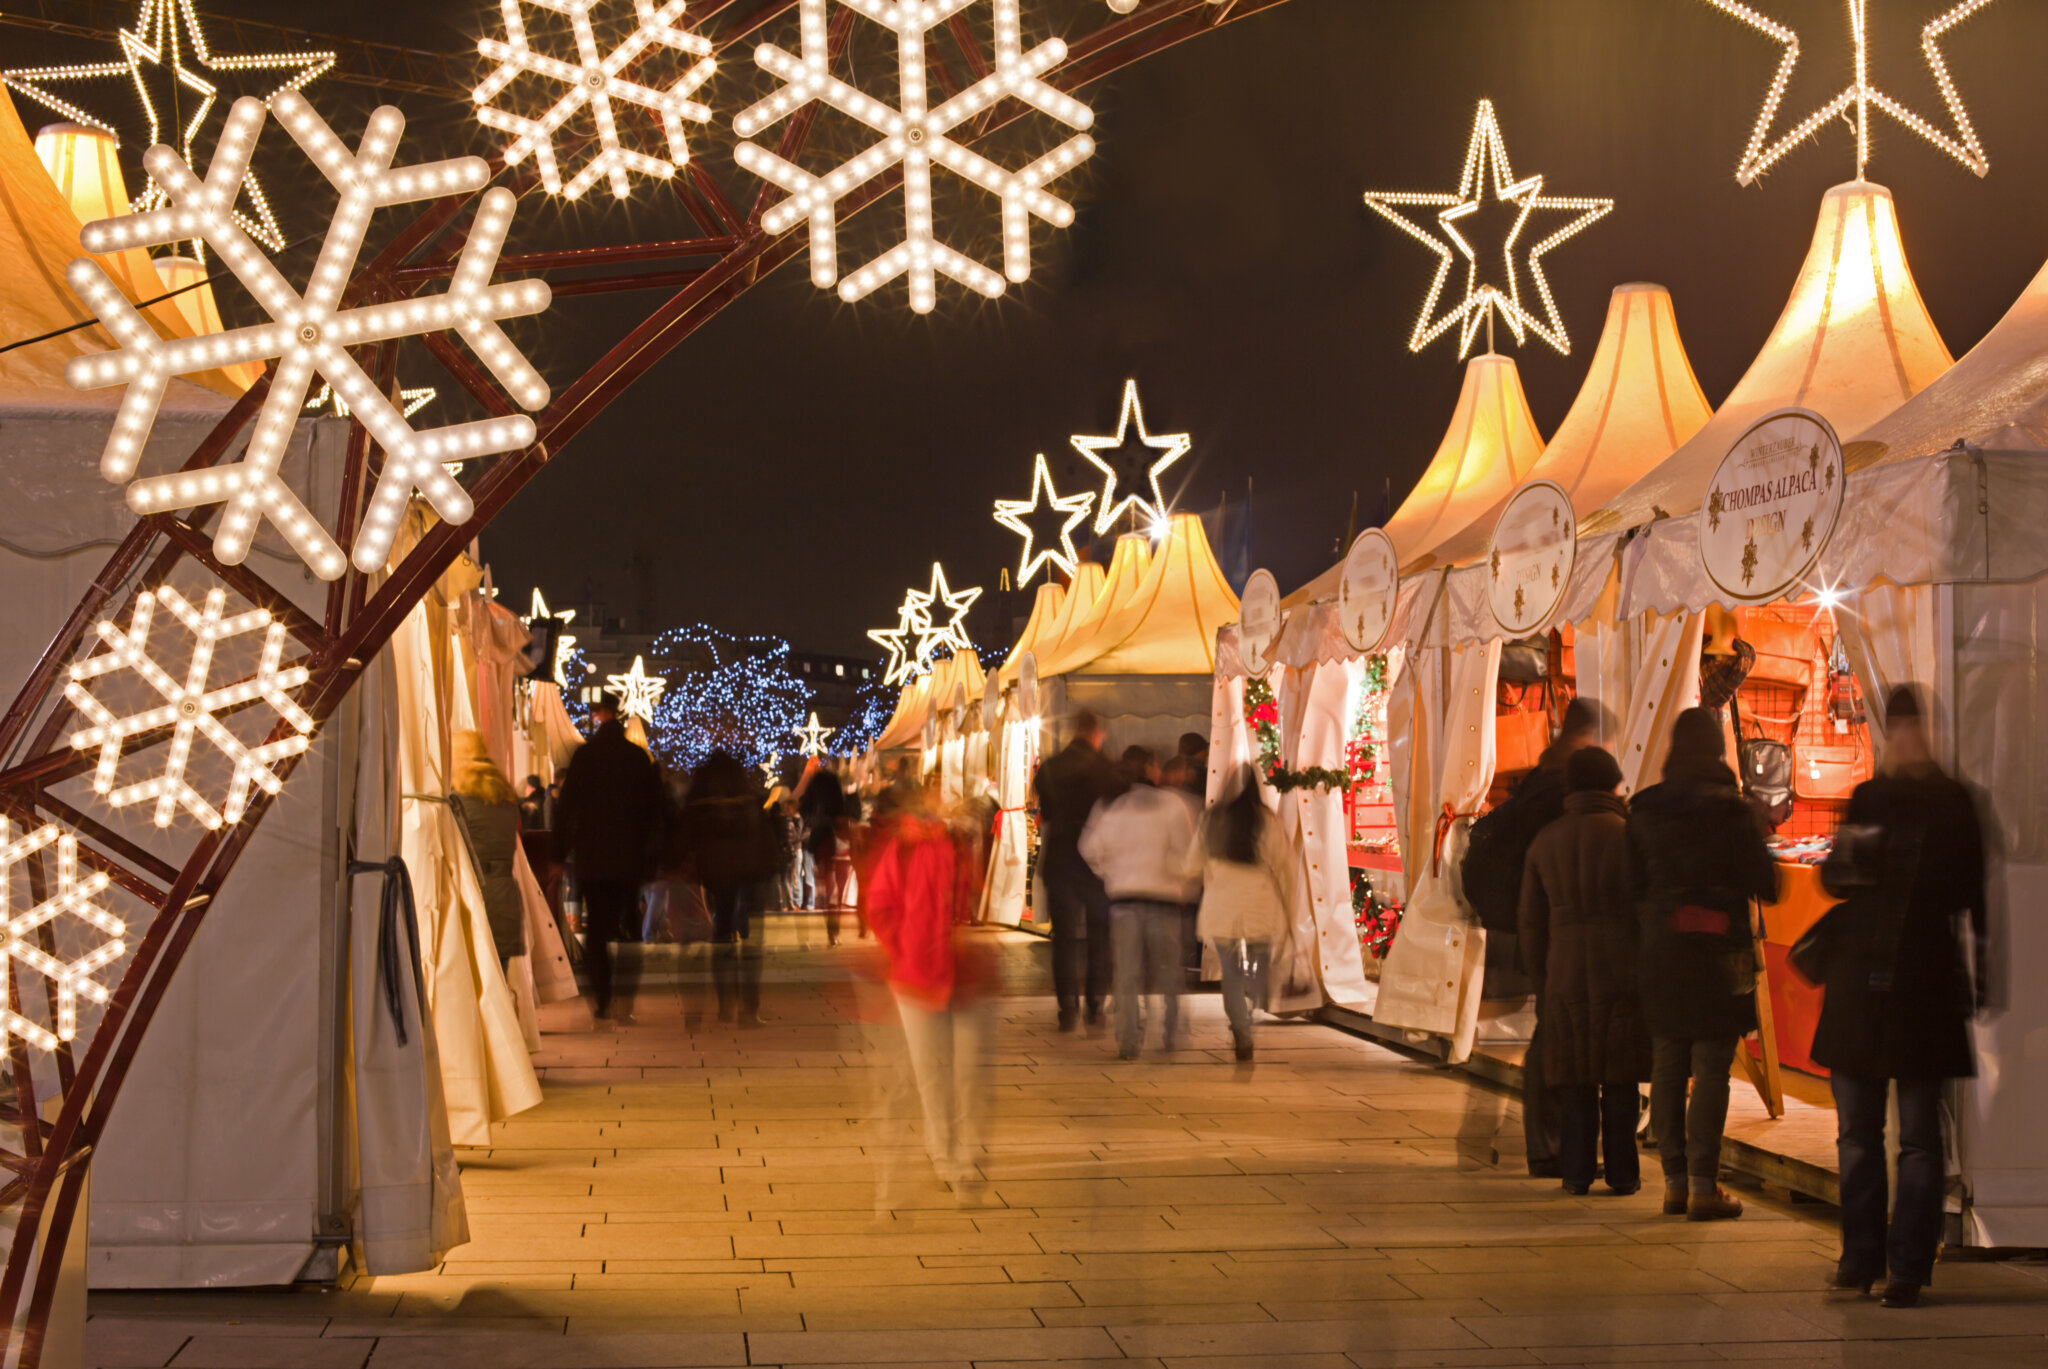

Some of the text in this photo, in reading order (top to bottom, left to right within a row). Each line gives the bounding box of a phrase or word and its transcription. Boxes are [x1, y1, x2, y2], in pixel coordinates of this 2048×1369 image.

[1722, 470, 1817, 513] CHOMPAS ALPACA
[1745, 510, 1787, 539] DESIGN
